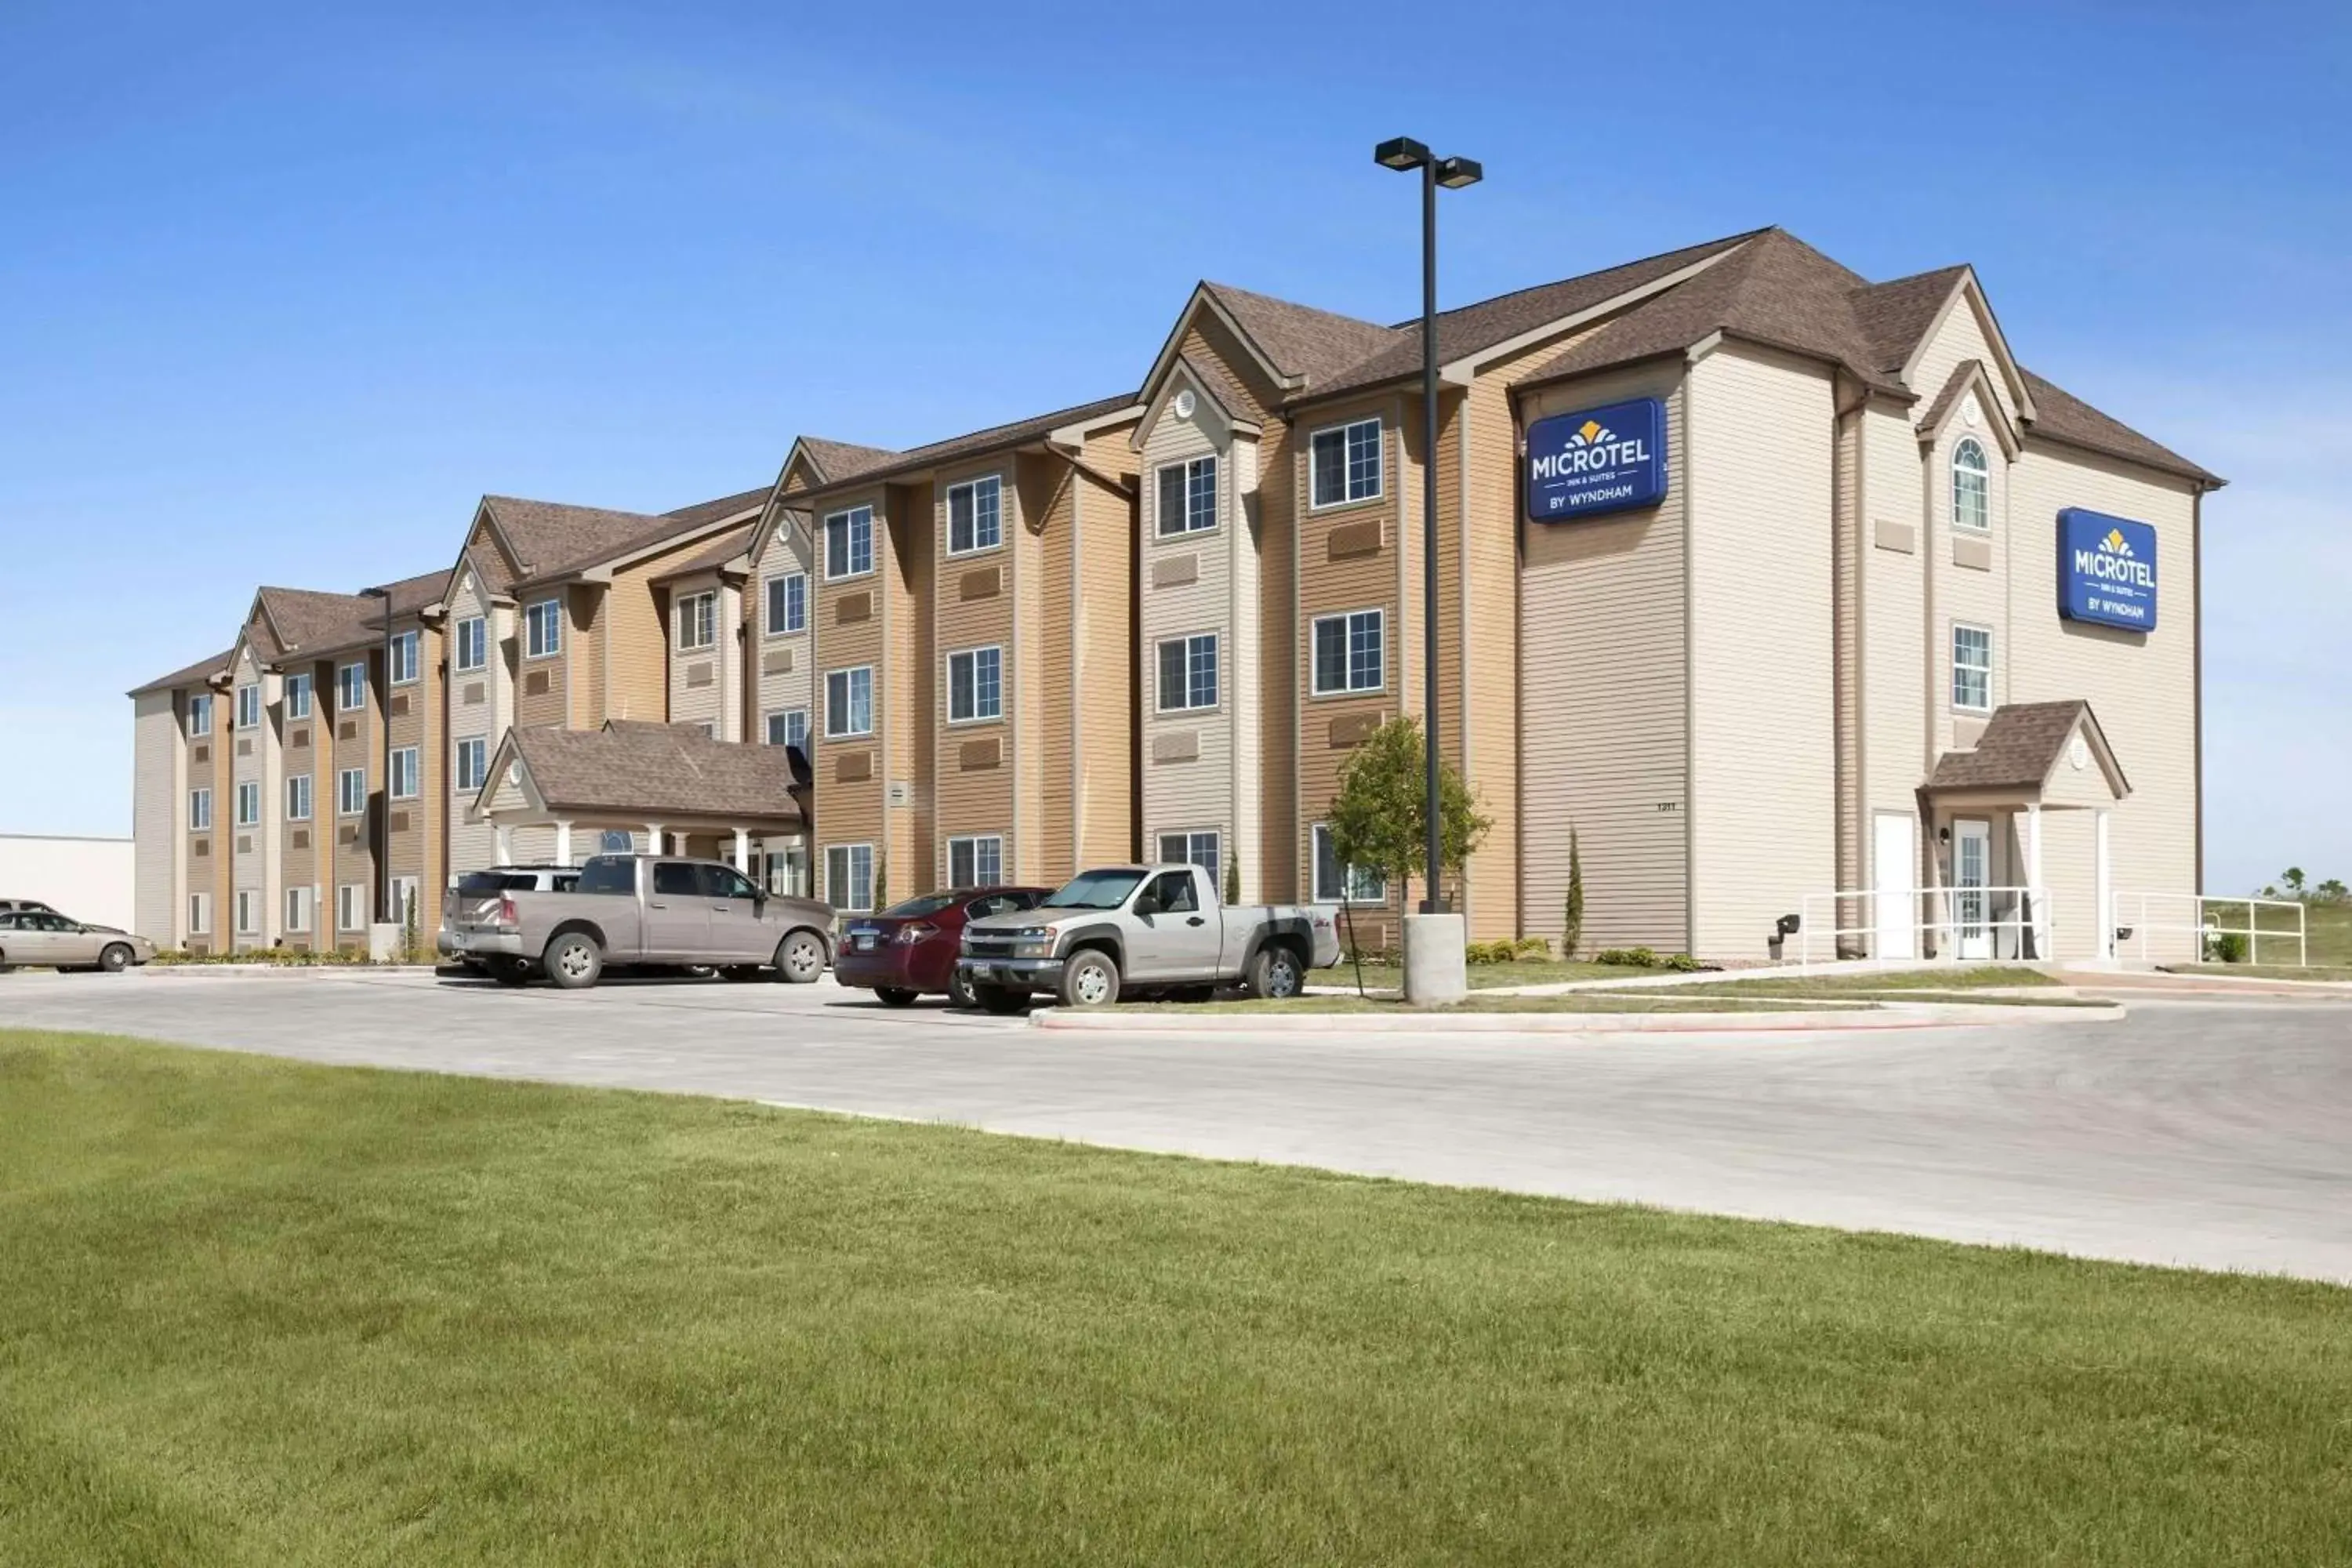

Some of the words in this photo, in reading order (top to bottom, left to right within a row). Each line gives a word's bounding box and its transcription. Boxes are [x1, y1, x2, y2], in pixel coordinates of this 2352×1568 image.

[1533, 439, 1650, 481] MICROTEL
[1588, 471, 1616, 484] SUITES
[1550, 496, 1566, 509] BY
[1570, 485, 1632, 506] WYNDHAM
[2075, 550, 2155, 587] MICROTEL
[2088, 597, 2100, 611] BY
[2103, 599, 2144, 618] WYNDHAM
